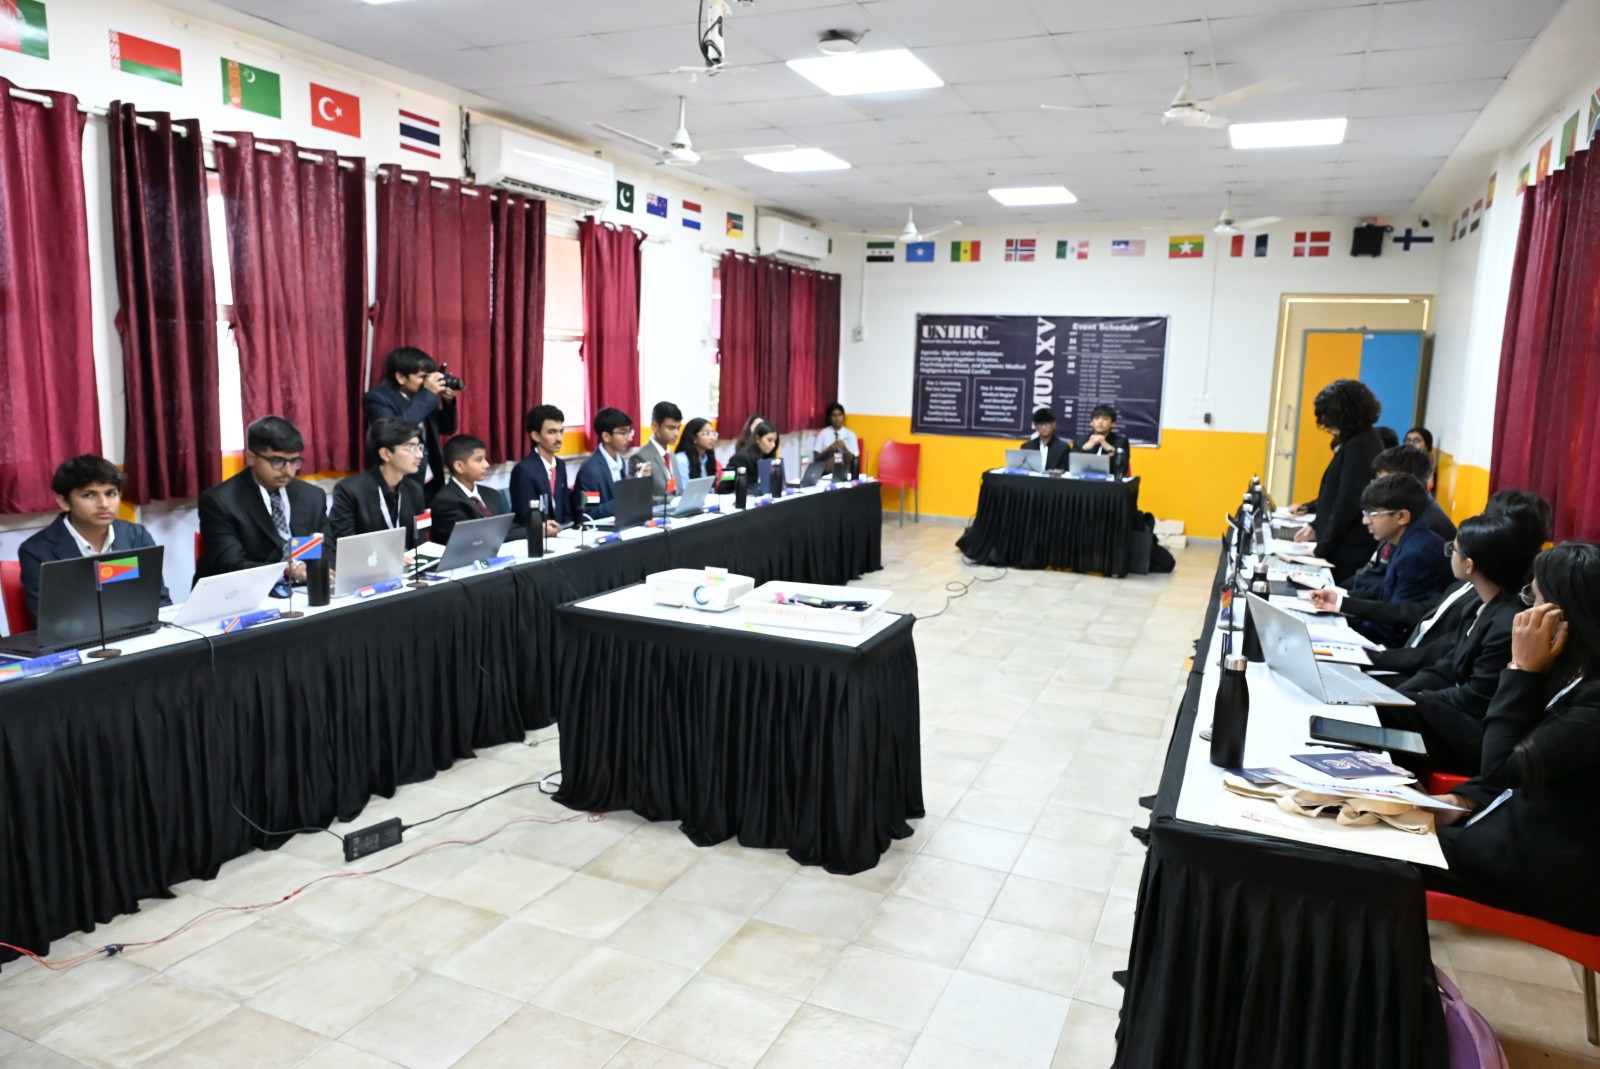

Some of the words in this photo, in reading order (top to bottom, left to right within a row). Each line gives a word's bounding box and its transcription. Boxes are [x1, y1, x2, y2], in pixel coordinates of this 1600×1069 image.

[922, 325, 989, 339] UNHRC
[1098, 323, 1139, 331] Schedule
[1036, 317, 1056, 356] XV
